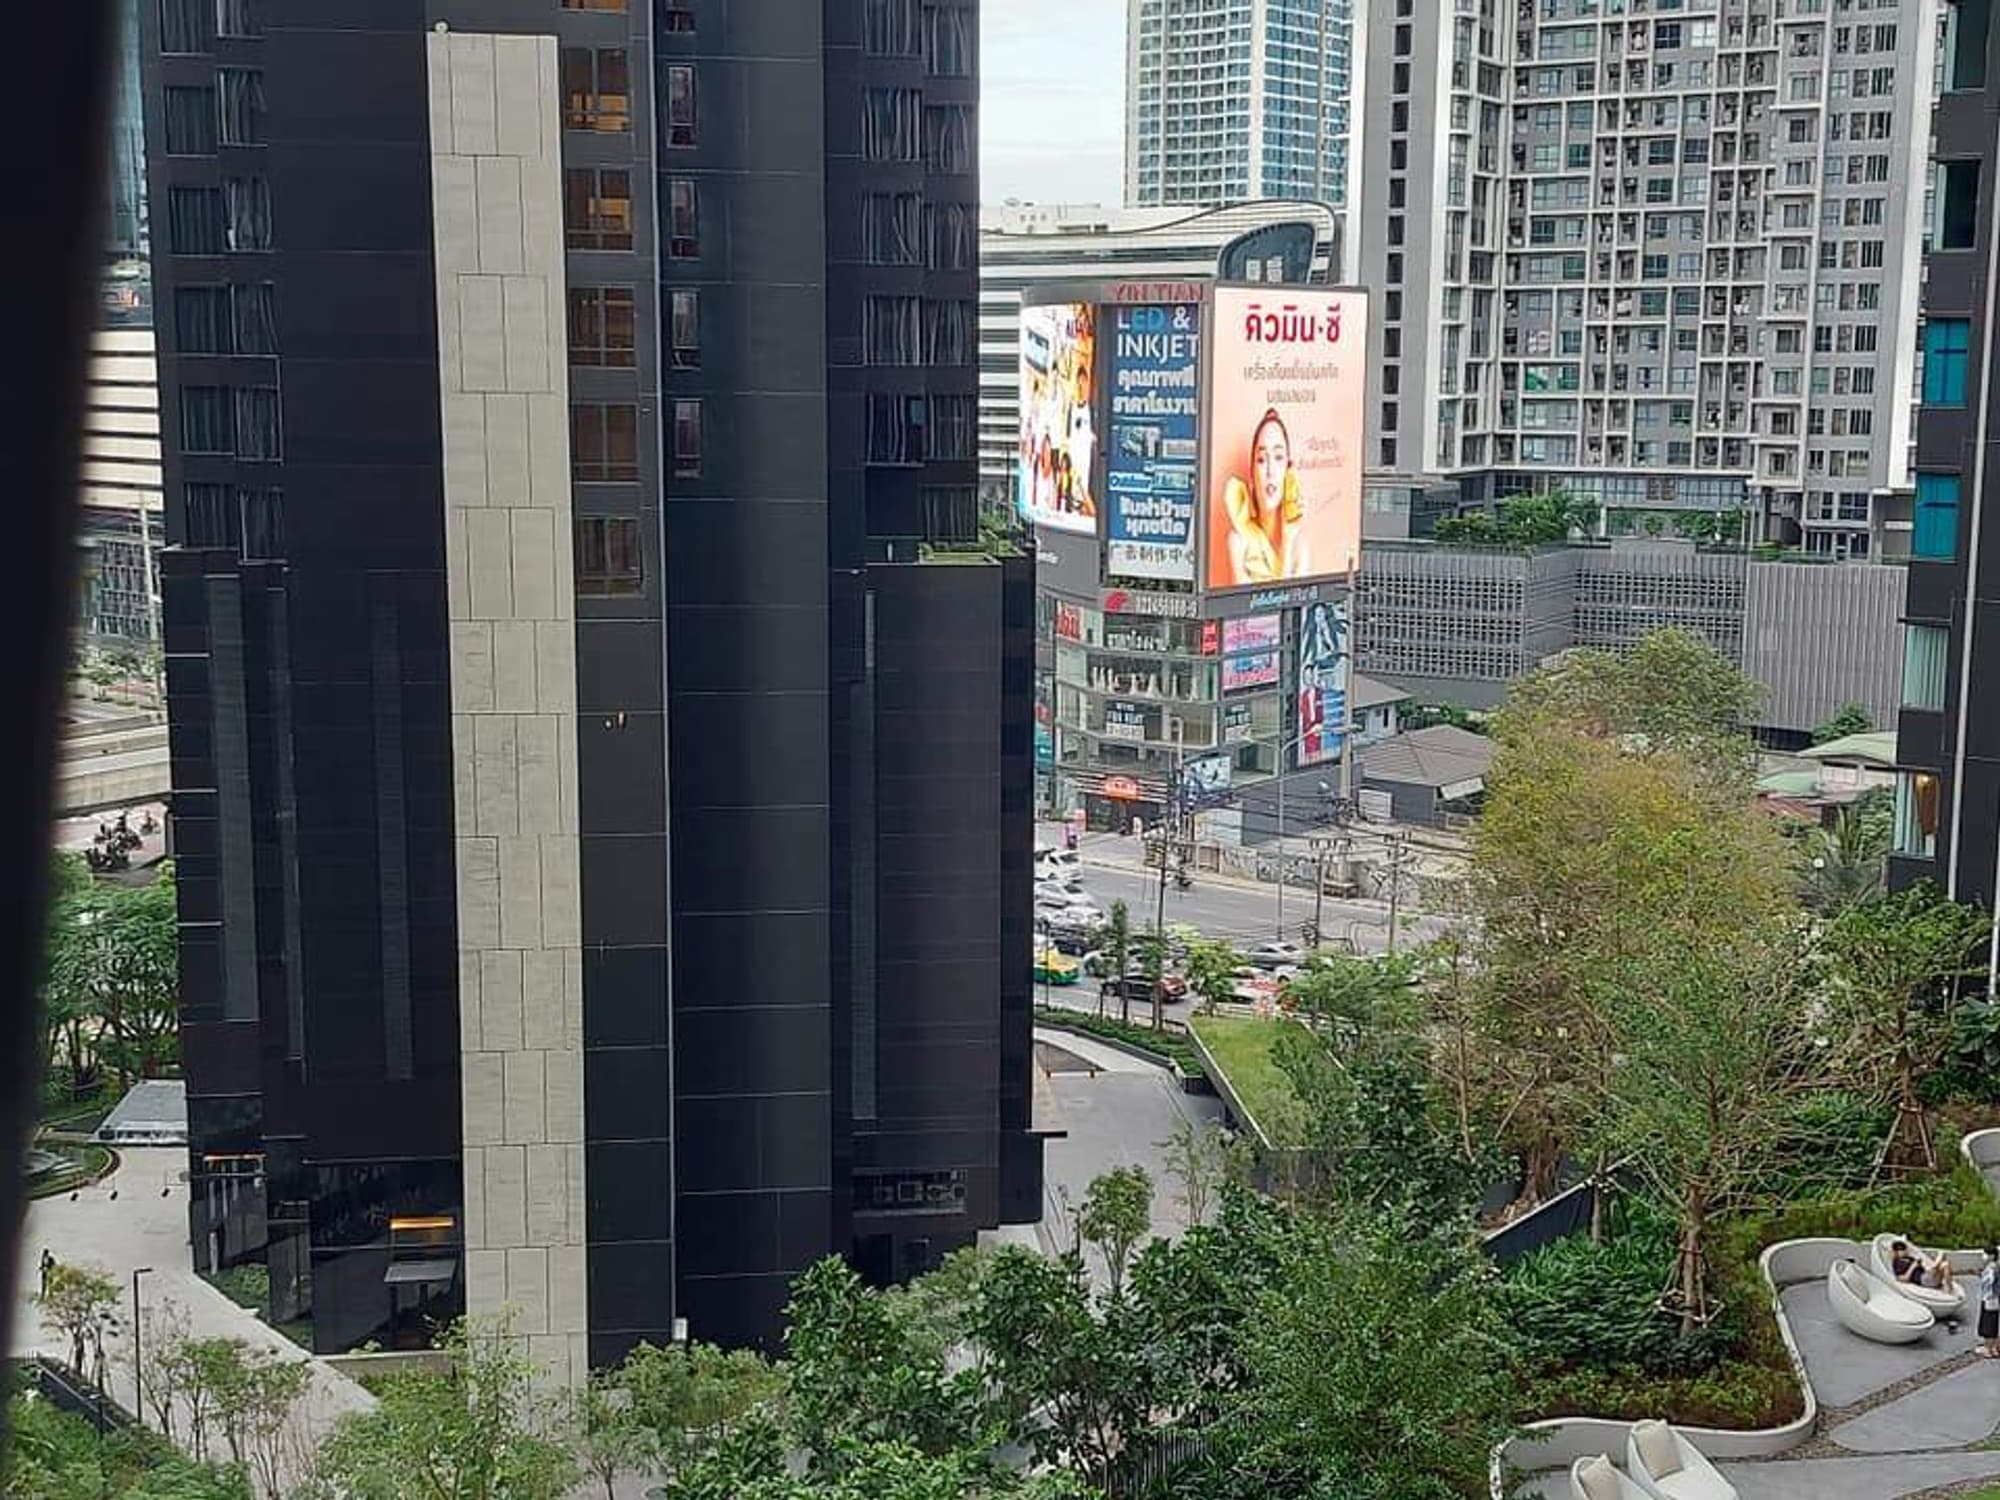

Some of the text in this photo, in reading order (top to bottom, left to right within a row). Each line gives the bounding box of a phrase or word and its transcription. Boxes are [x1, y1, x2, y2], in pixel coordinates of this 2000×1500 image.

[1117, 307, 1165, 332] LED
[1173, 306, 1191, 329] &
[1117, 333, 1199, 364] INKJET
